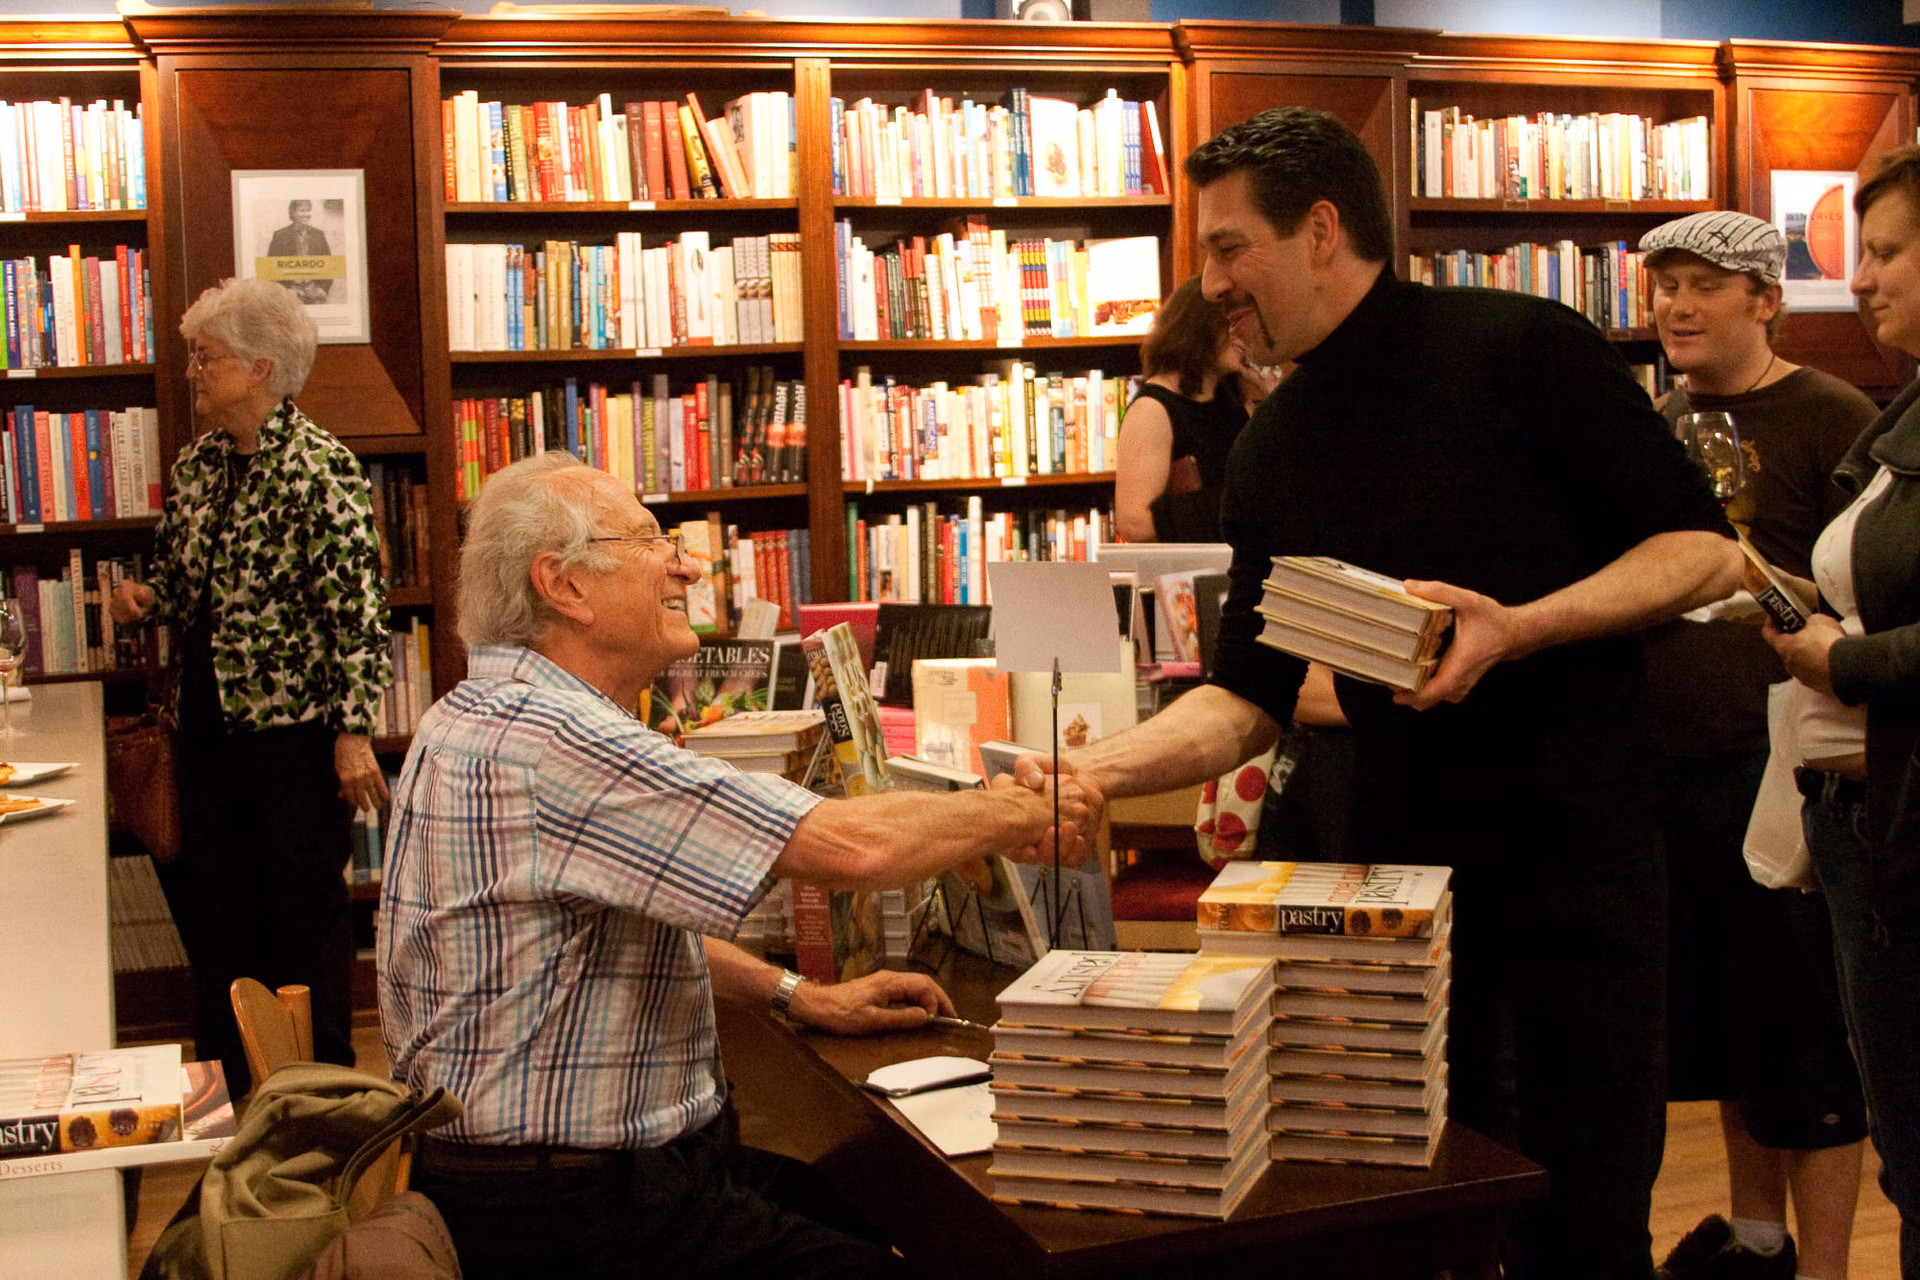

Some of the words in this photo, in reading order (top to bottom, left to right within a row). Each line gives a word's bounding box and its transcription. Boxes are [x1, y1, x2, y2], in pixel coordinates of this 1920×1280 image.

[446, 162, 455, 188] ITALY
[1785, 212, 1842, 221] WINERIES
[277, 260, 324, 269] RICARDO
[887, 378, 895, 386] A
[774, 386, 787, 432] MOVIDA
[793, 385, 806, 431] MOVIDA
[887, 388, 896, 412] Great
[888, 413, 898, 453] American
[927, 401, 938, 450] AMERICAN
[890, 454, 899, 476] Cook
[676, 646, 770, 664] ETABLES
[705, 668, 738, 678] FRENCH
[739, 669, 768, 678] CHEFS
[827, 703, 850, 737] eggs
[1281, 905, 1345, 933] pastry
[0, 1120, 60, 1151] stry
[0, 1158, 64, 1176] Desserts
